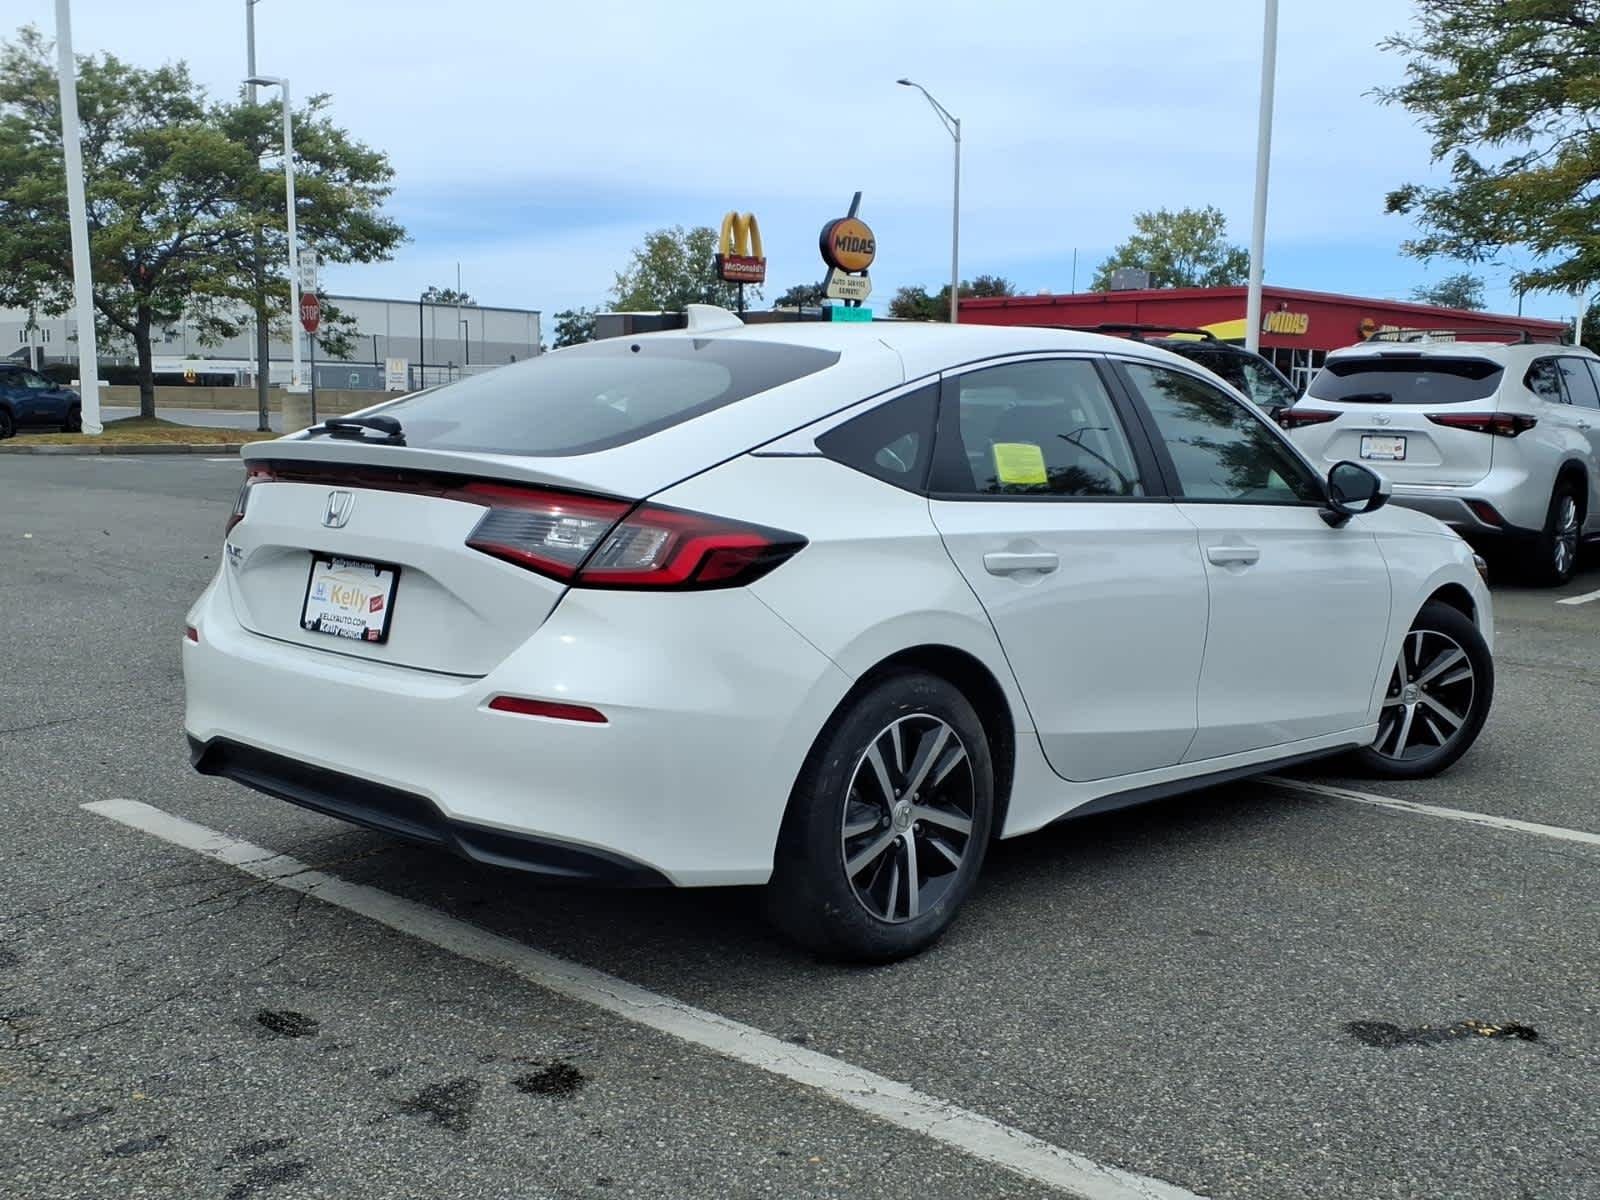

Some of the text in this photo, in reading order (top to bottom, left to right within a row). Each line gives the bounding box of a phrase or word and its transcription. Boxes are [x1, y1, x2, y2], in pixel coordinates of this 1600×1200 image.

[835, 234, 875, 255] MIDAS
[302, 305, 319, 321] STOP
[1264, 311, 1309, 335] MIDAS
[330, 584, 368, 613] Kelly
